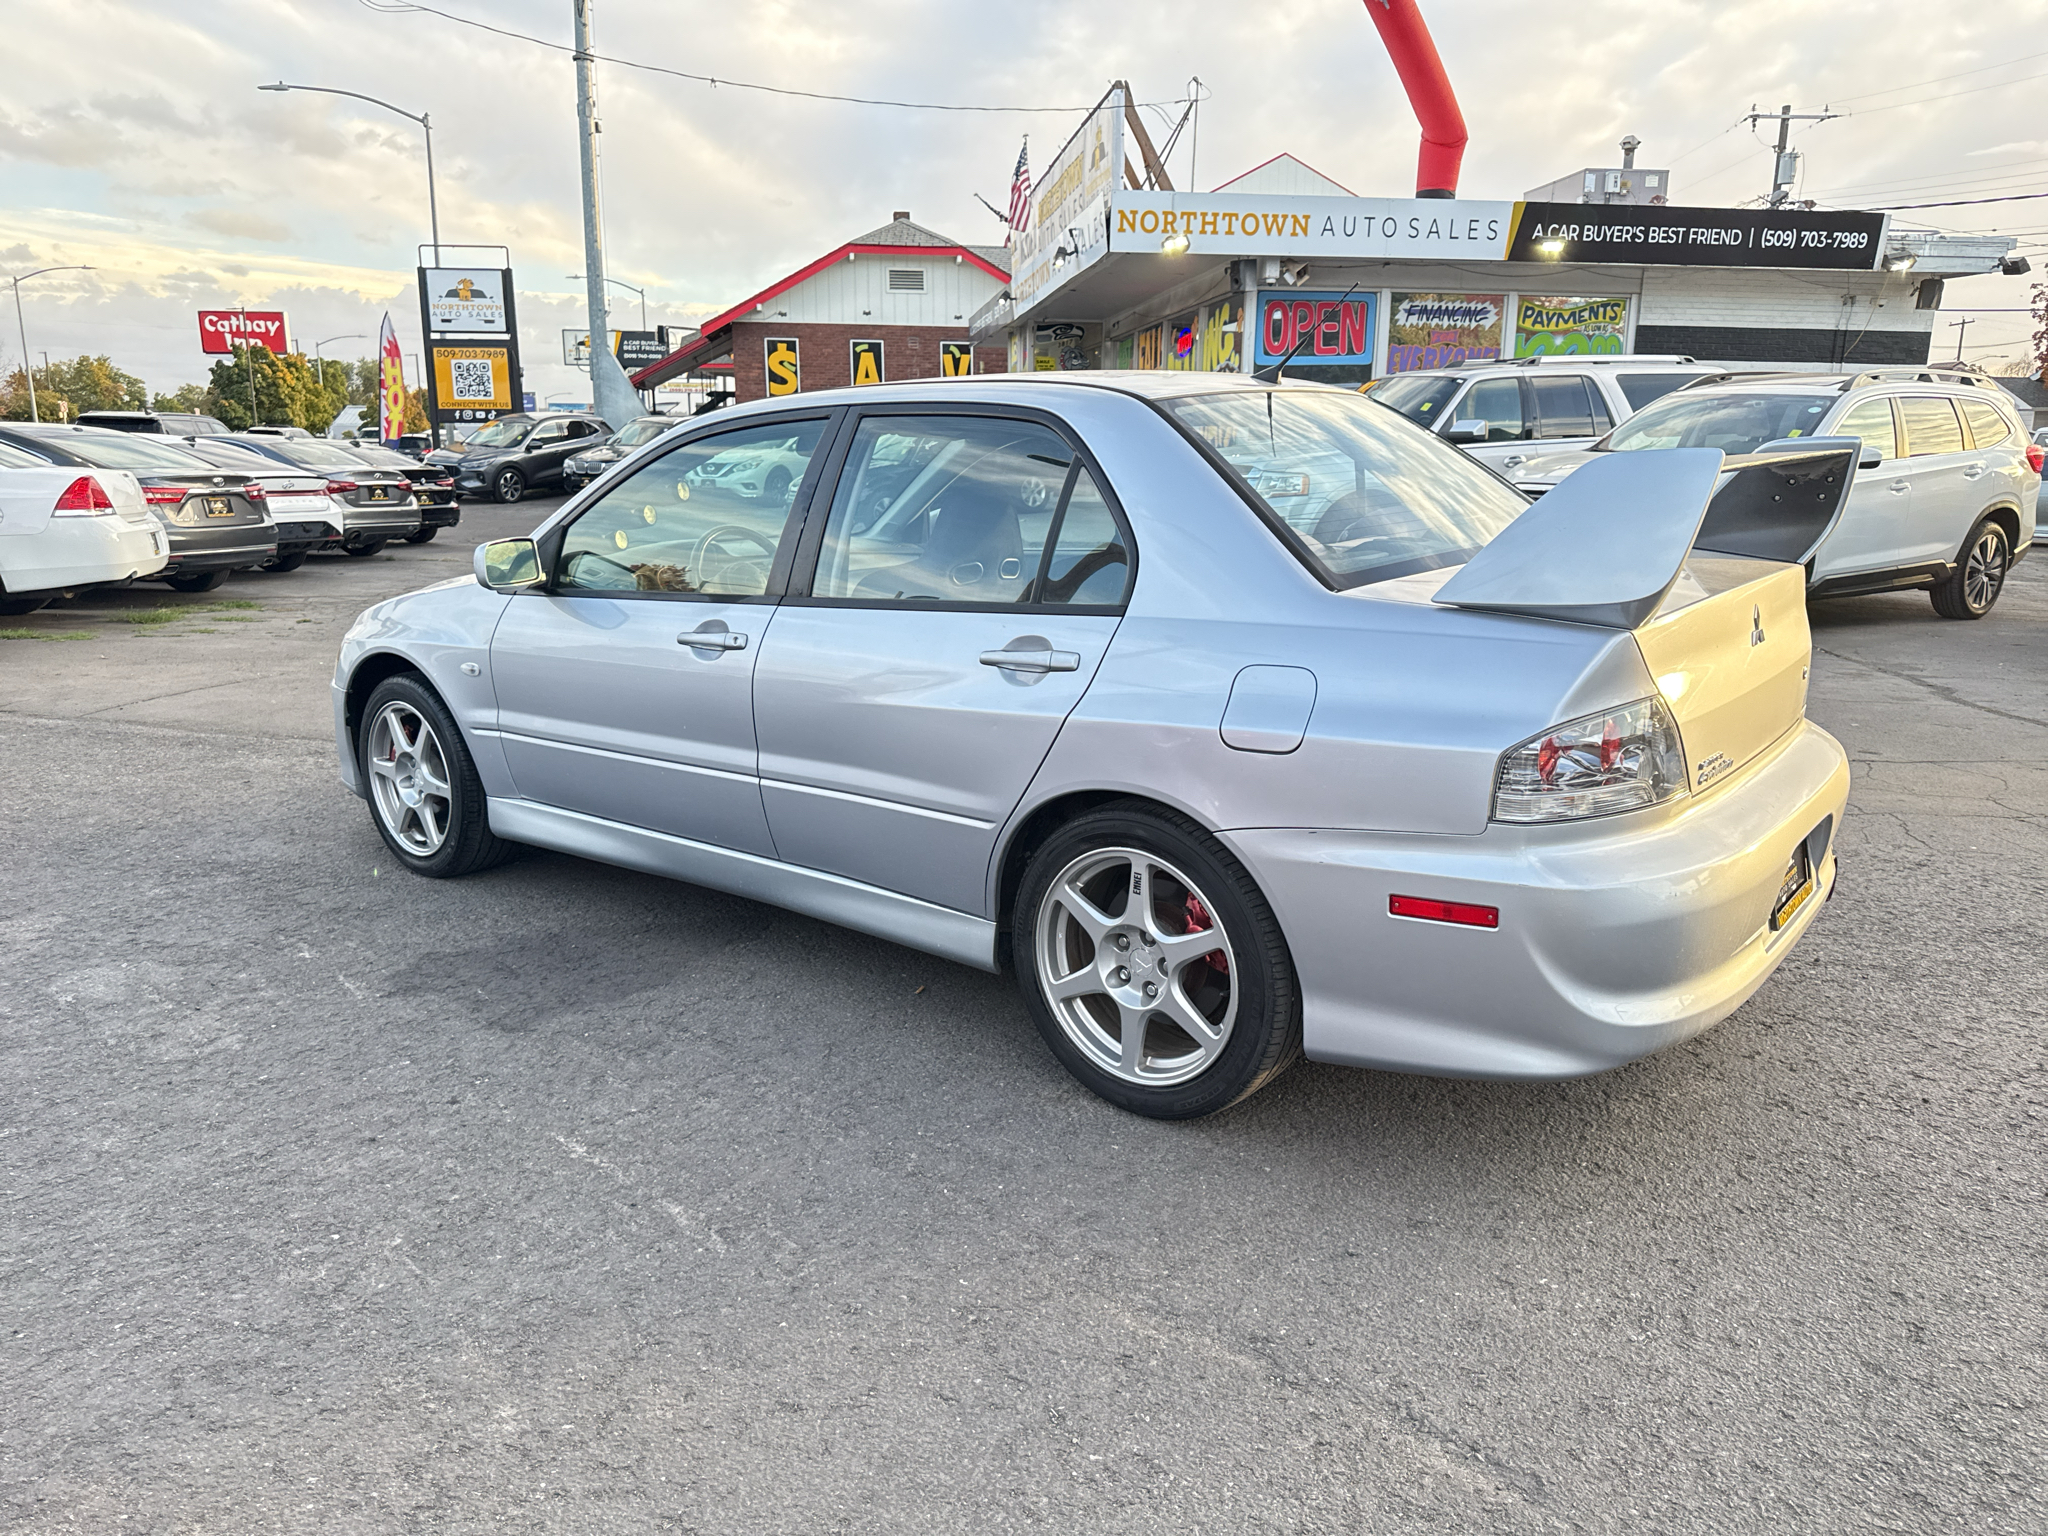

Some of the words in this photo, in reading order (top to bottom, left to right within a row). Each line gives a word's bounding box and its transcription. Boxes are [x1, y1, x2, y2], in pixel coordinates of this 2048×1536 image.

[1117, 208, 1311, 237] NORTHTOWN
[1320, 214, 1398, 239] AUTO
[1407, 217, 1500, 242] SALES
[1532, 223, 1544, 241] A
[1547, 223, 1579, 242] CAR
[1583, 225, 1645, 243] BUYER'S
[1648, 227, 1687, 244] BEST
[1689, 228, 1743, 247] FRIEND
[1761, 228, 1797, 250] (509)
[1800, 230, 1868, 250] 703-7989
[431, 303, 503, 311] NORTHTOWN
[432, 310, 462, 318] AUTO
[1405, 304, 1489, 323] FINANCING
[1521, 301, 1622, 329] PAYMENTS
[204, 314, 281, 337] Cathay
[1263, 300, 1368, 356] OPEN
[383, 356, 405, 440] HOT
